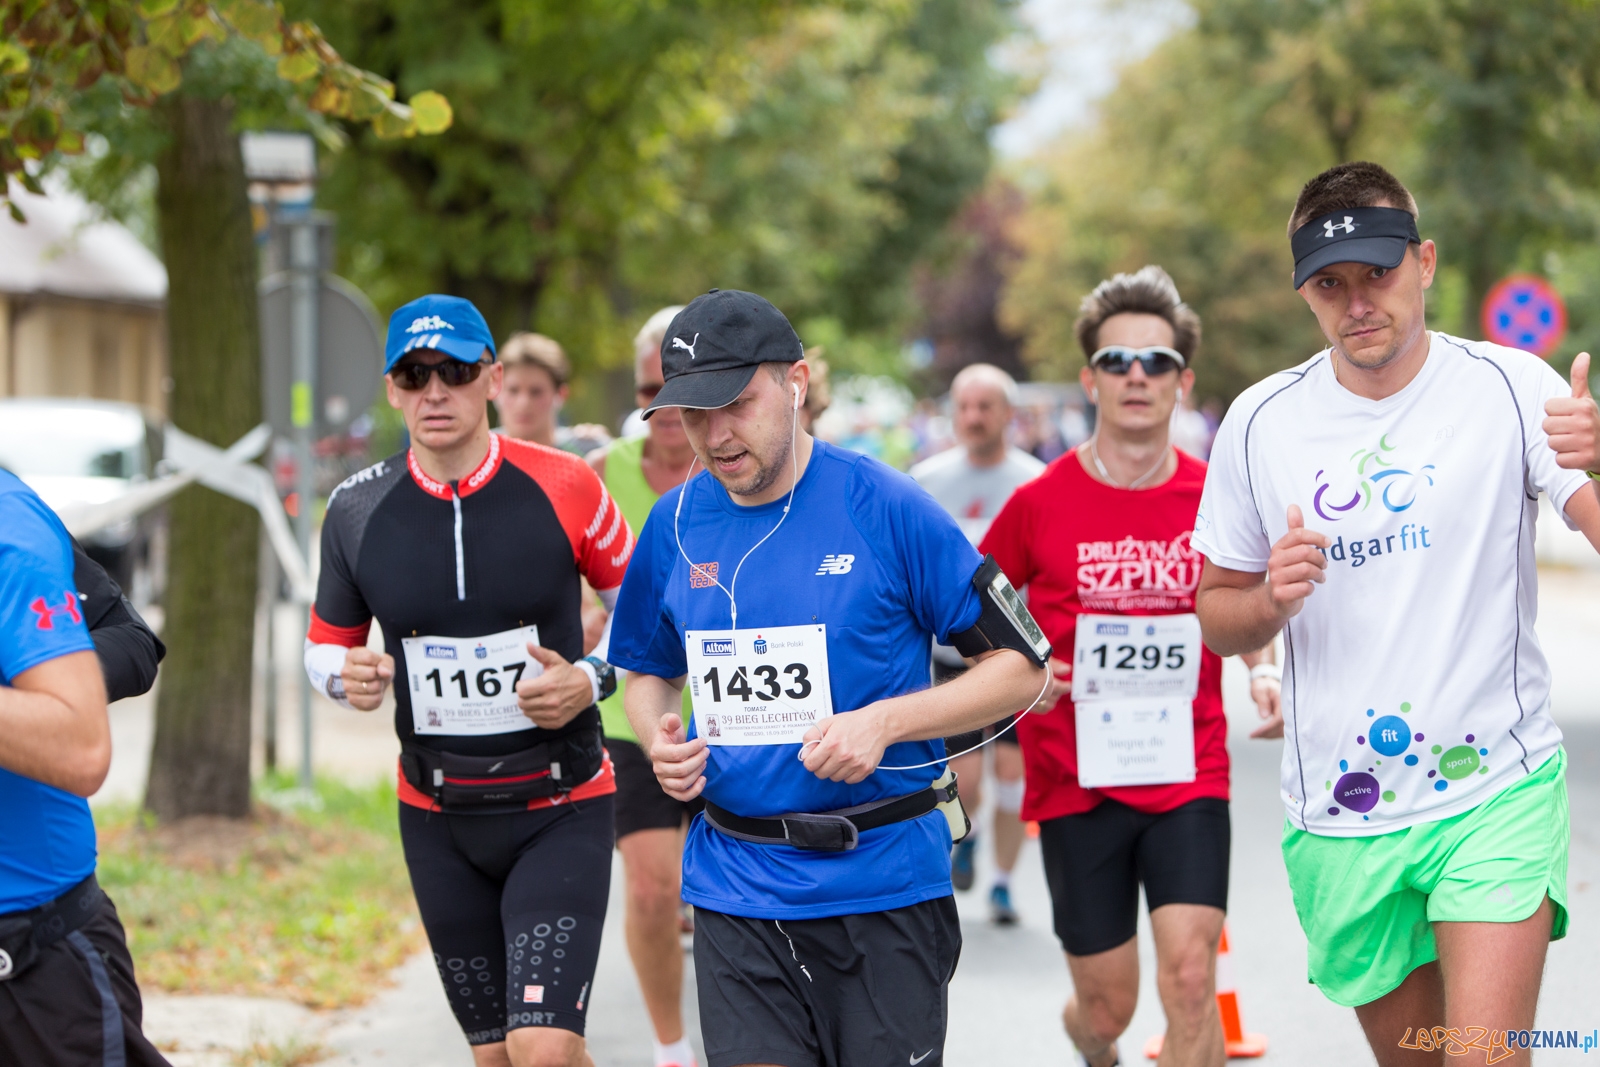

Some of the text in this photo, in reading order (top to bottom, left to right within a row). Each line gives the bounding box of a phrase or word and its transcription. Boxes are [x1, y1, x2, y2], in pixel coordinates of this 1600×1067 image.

[1076, 534, 1181, 564] DRUŻYNA
[1076, 560, 1201, 596] SZPIKU
[787, 640, 804, 648] Polski
[1092, 644, 1186, 670] 1295
[426, 661, 527, 699] 1167
[703, 662, 812, 703] 1433
[483, 704, 519, 716] LECHIT
[721, 709, 817, 725] 39 BIEG LECHITÓW
[1381, 729, 1398, 743] fit
[1446, 756, 1472, 770] sport
[1344, 786, 1372, 798] active
